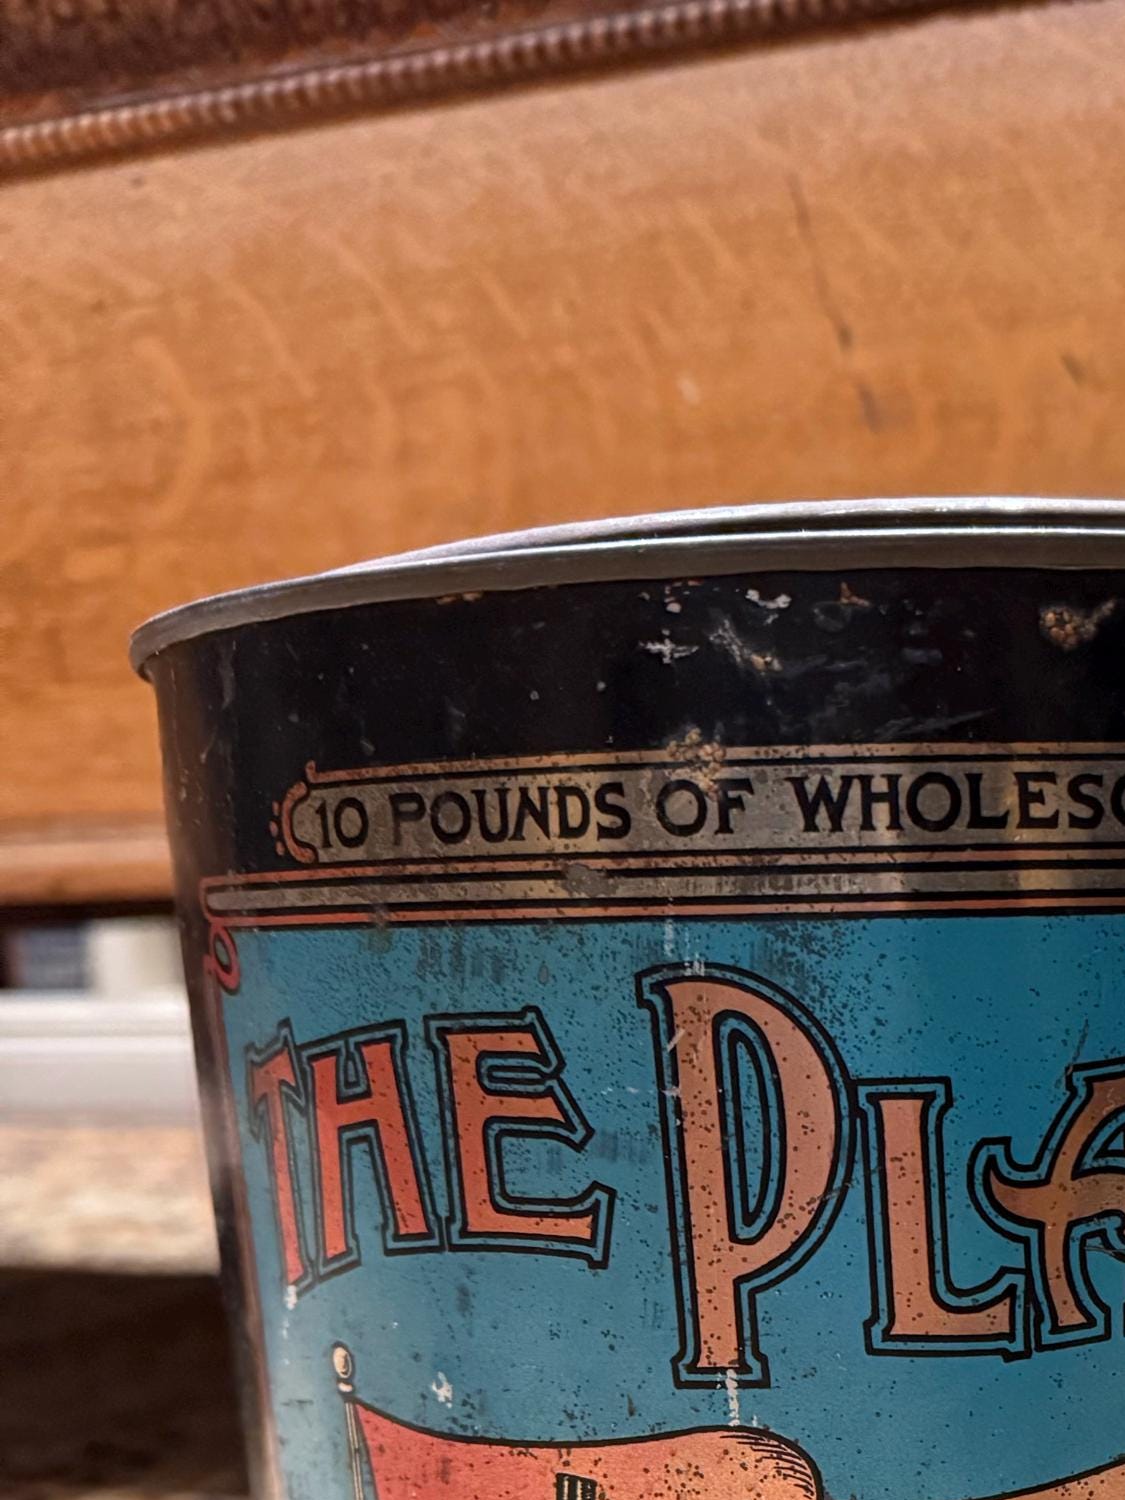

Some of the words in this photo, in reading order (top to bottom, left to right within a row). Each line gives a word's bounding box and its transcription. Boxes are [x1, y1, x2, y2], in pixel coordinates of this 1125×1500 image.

[317, 797, 369, 848] 10
[392, 781, 631, 844] POUNDS
[655, 779, 754, 837] OF
[244, 1005, 616, 1293] THE
